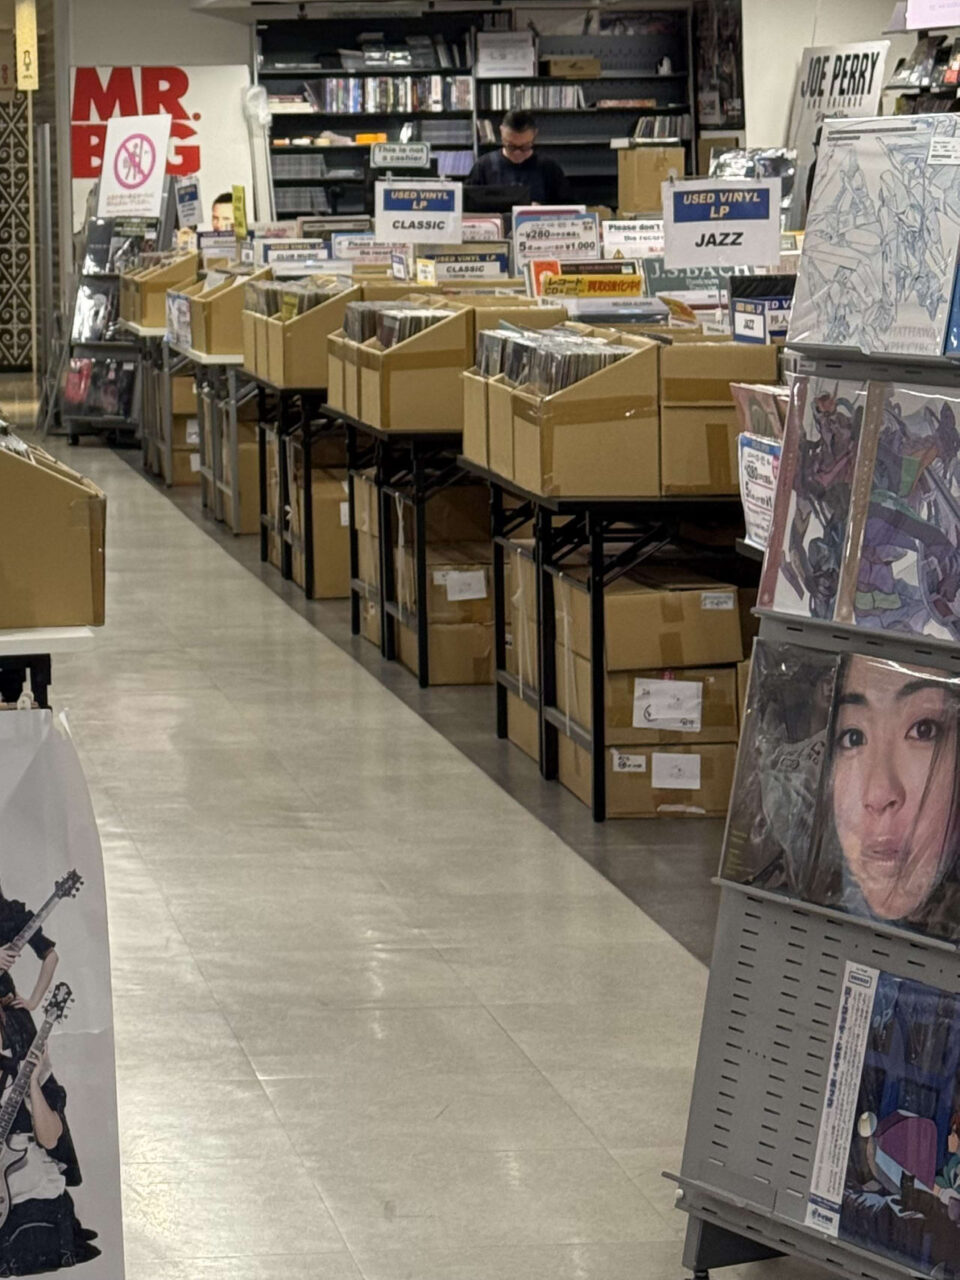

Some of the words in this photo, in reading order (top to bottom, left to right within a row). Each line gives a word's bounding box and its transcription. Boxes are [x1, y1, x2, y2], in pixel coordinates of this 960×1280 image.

[801, 55, 830, 98] JOE
[830, 51, 880, 97] PERRY
[71, 66, 202, 121] MR.
[71, 122, 201, 178] BG
[378, 145, 396, 153] This
[399, 145, 408, 153] is
[409, 145, 424, 153] not
[391, 191, 417, 200] USED
[420, 191, 449, 200] VINYL
[683, 193, 717, 205] USED
[719, 191, 761, 204] VINYL
[412, 200, 428, 210] LP
[709, 206, 730, 219] LP
[392, 220, 446, 231] CLASSIC
[609, 223, 637, 231] Please
[695, 231, 744, 249] JAZZ
[446, 265, 485, 273] CLASSIC
